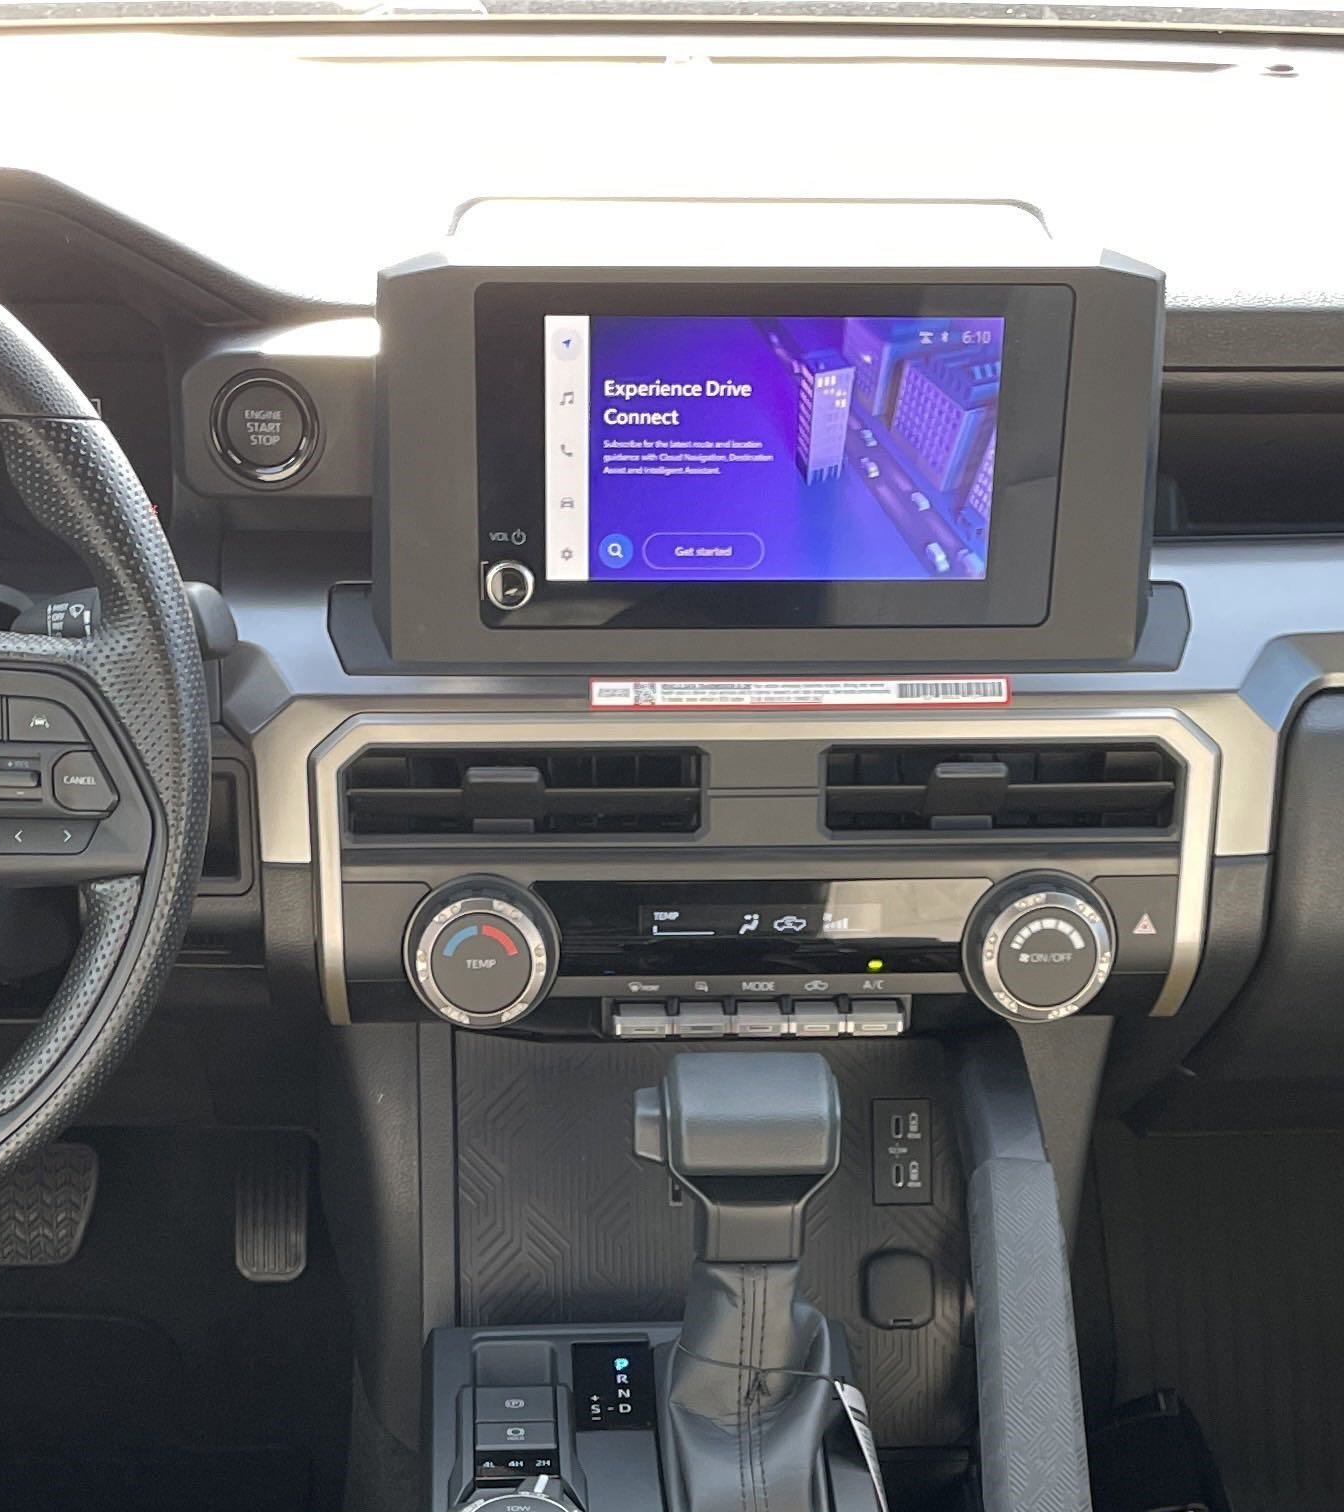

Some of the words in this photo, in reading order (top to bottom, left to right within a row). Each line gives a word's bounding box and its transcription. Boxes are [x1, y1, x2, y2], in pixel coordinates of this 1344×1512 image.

[962, 330, 991, 344] 6:10
[604, 380, 702, 400] Experience
[706, 380, 752, 397] Drive
[244, 409, 281, 420] ENGINE
[603, 408, 680, 425] Connect
[246, 422, 281, 433] START
[250, 434, 281, 446] STOP
[489, 532, 509, 542] VOL
[674, 546, 694, 557] Get
[696, 546, 733, 557] started
[63, 775, 96, 786] CANCEL
[653, 912, 679, 921] TEMP
[466, 959, 496, 969] TEMP
[742, 981, 776, 991] MODE
[862, 980, 884, 990] A/C
[613, 1357, 629, 1371] P
[616, 1374, 629, 1384] R
[617, 1388, 631, 1398] N
[618, 1403, 632, 1414] D
[508, 1460, 524, 1468] 4H
[535, 1459, 551, 1467] 2H
